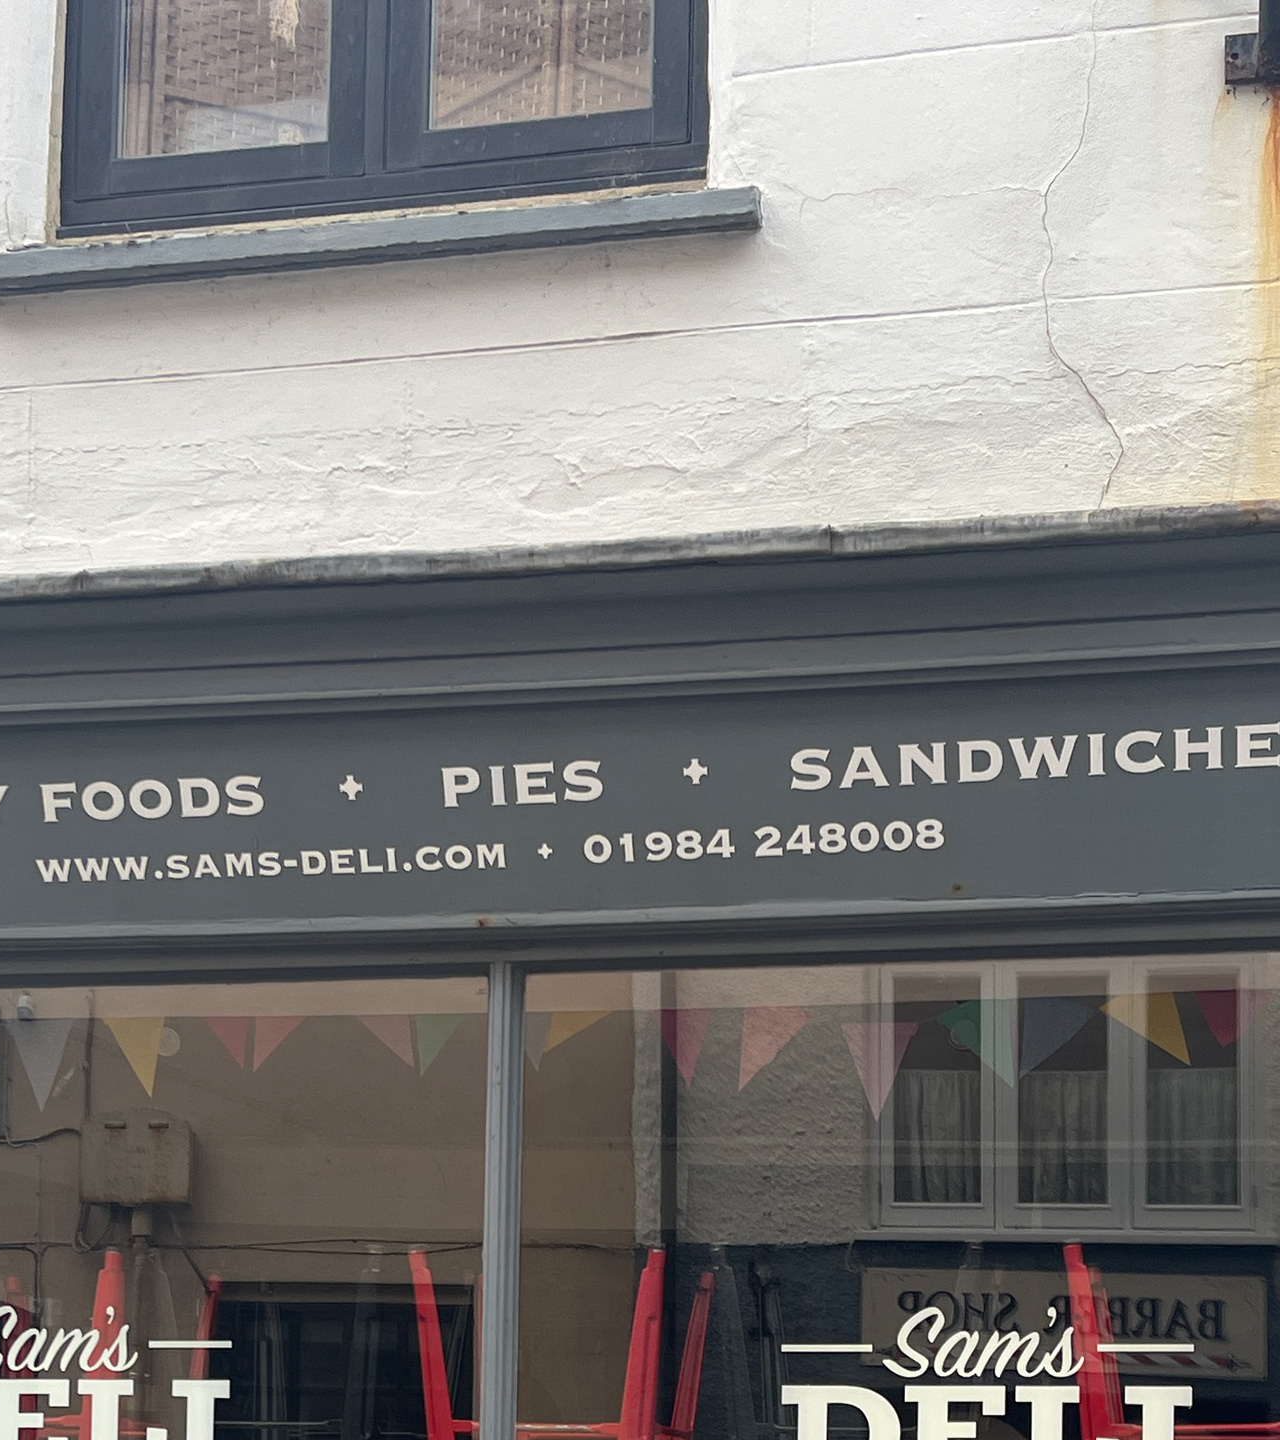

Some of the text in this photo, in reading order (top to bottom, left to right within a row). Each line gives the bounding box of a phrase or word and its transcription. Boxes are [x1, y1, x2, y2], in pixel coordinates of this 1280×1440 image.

[40, 775, 265, 823] FOODS
[441, 759, 604, 809] PIES
[35, 818, 946, 884] WWW.SAMS-DELI.COM 01984 248008
[882, 1306, 1085, 1378] Sam's
